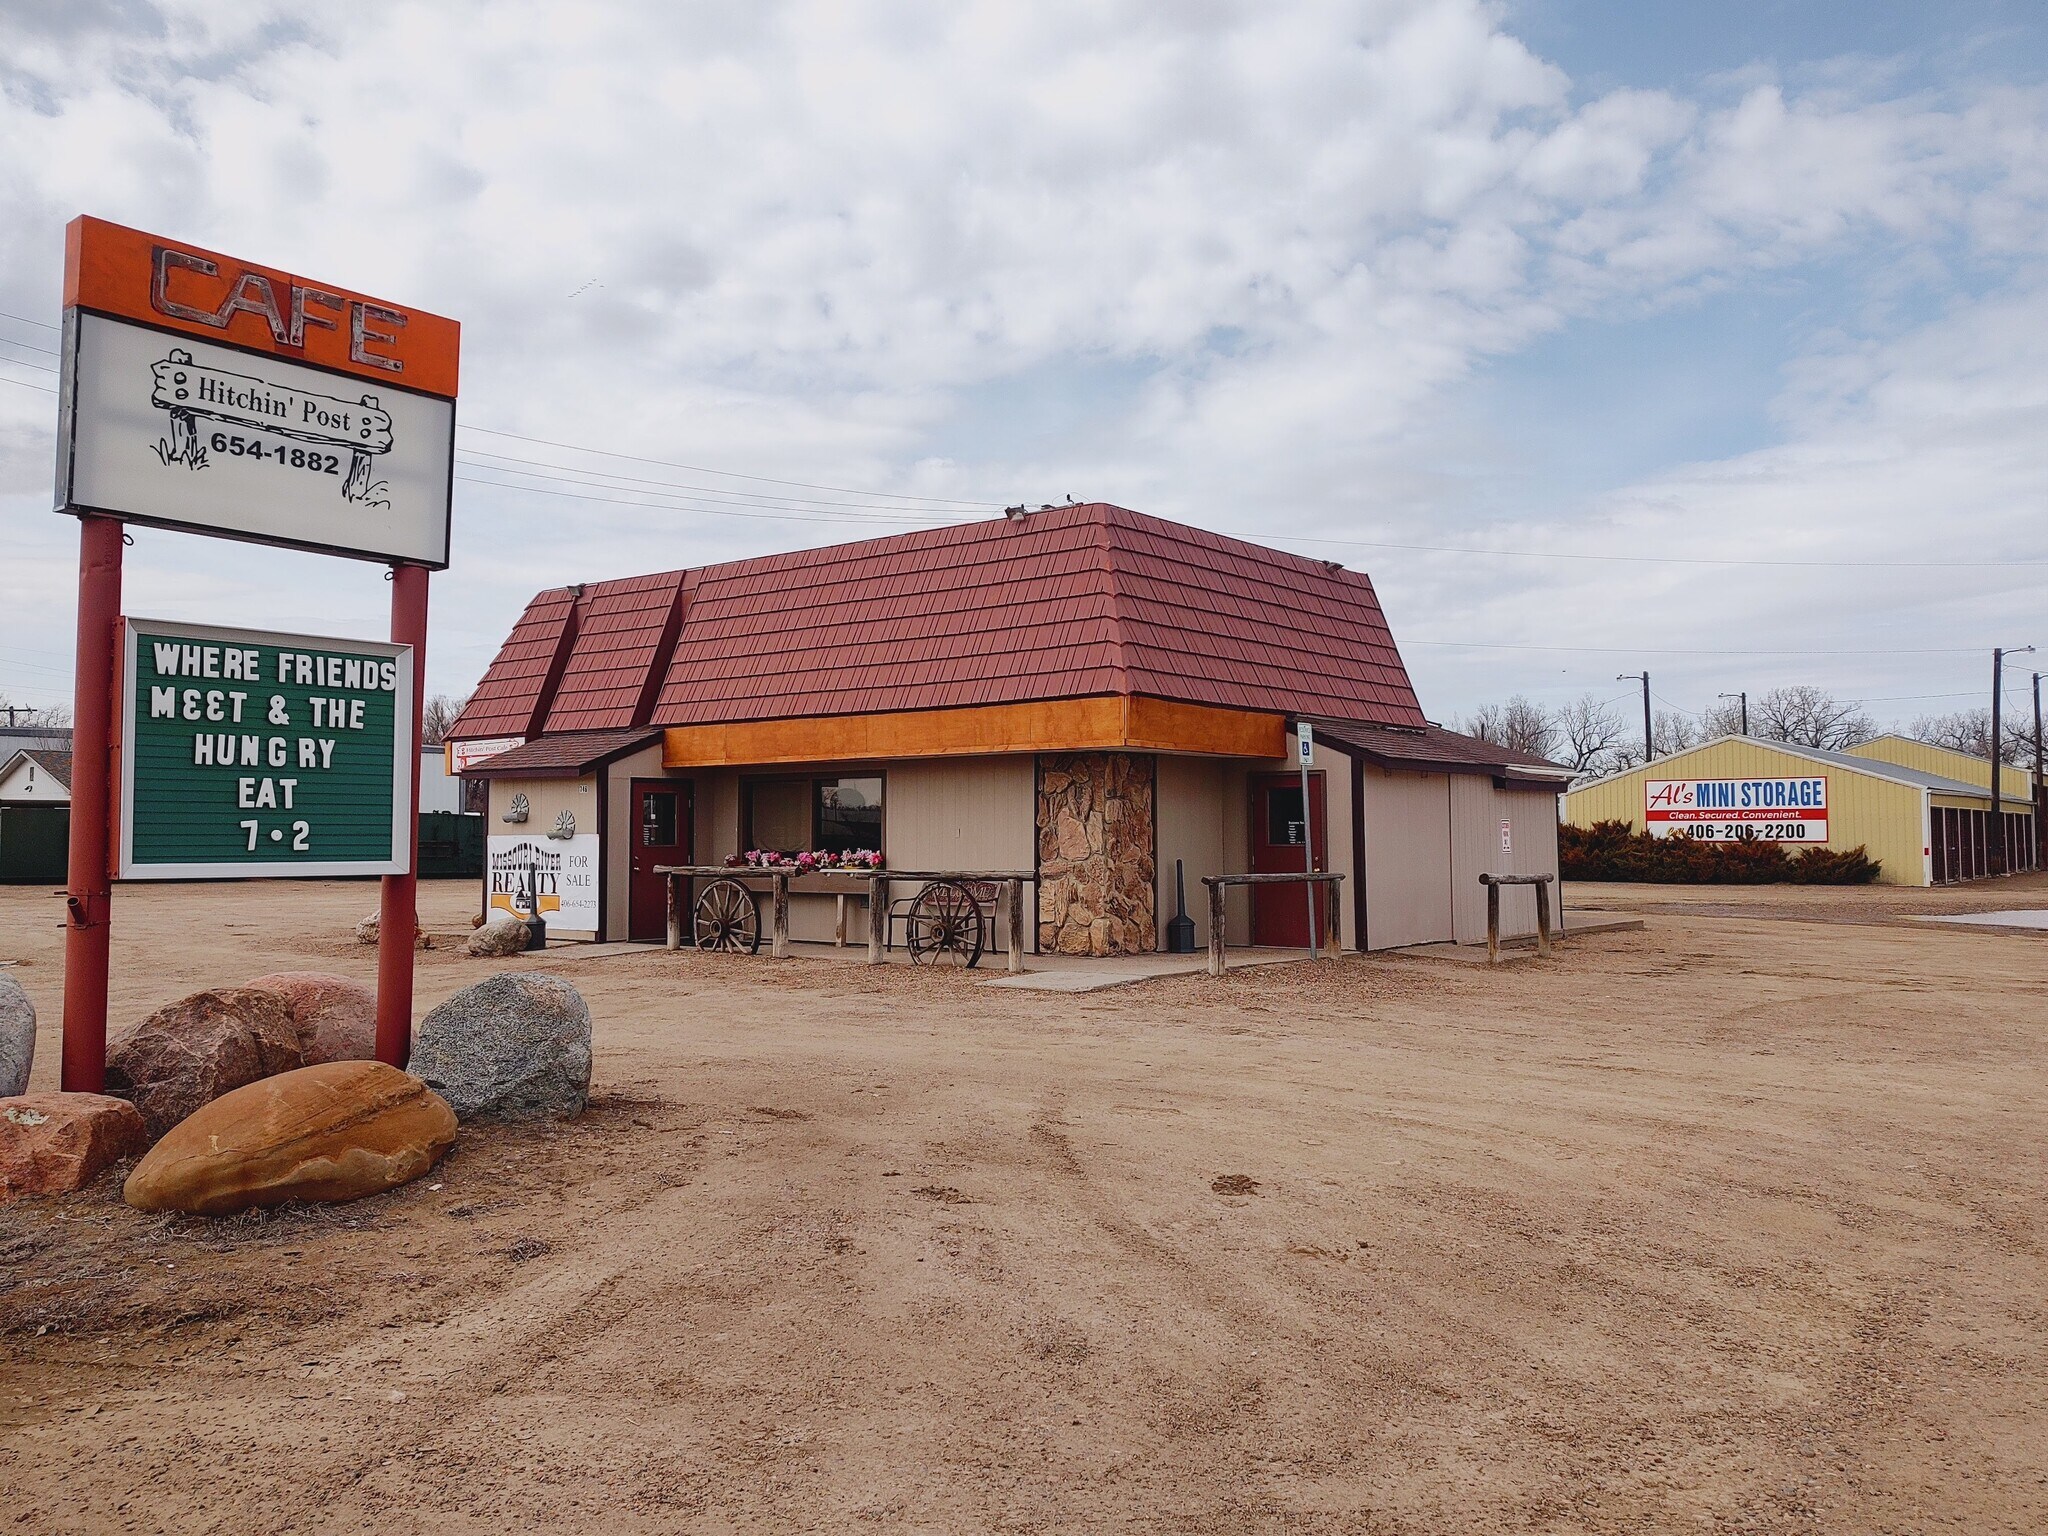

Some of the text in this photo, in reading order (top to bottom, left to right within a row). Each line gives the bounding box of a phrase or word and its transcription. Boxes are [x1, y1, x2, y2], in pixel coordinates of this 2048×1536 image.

[151, 244, 409, 373] CAFE
[198, 376, 351, 431] Hitchin' Post
[210, 432, 340, 475] 654-1882
[153, 642, 396, 691] WHERE FRIENDS
[151, 686, 366, 730] MEET & THE
[238, 777, 298, 809] EAT
[1650, 780, 1823, 809] Al's MINI STORAGE
[1669, 810, 1802, 820] Clean. Secured. Convenient.
[1687, 823, 1806, 839] 406-206-2200
[492, 842, 561, 870] MISSOURI RIVER
[568, 855, 589, 868] FOR
[566, 873, 592, 887] SALE
